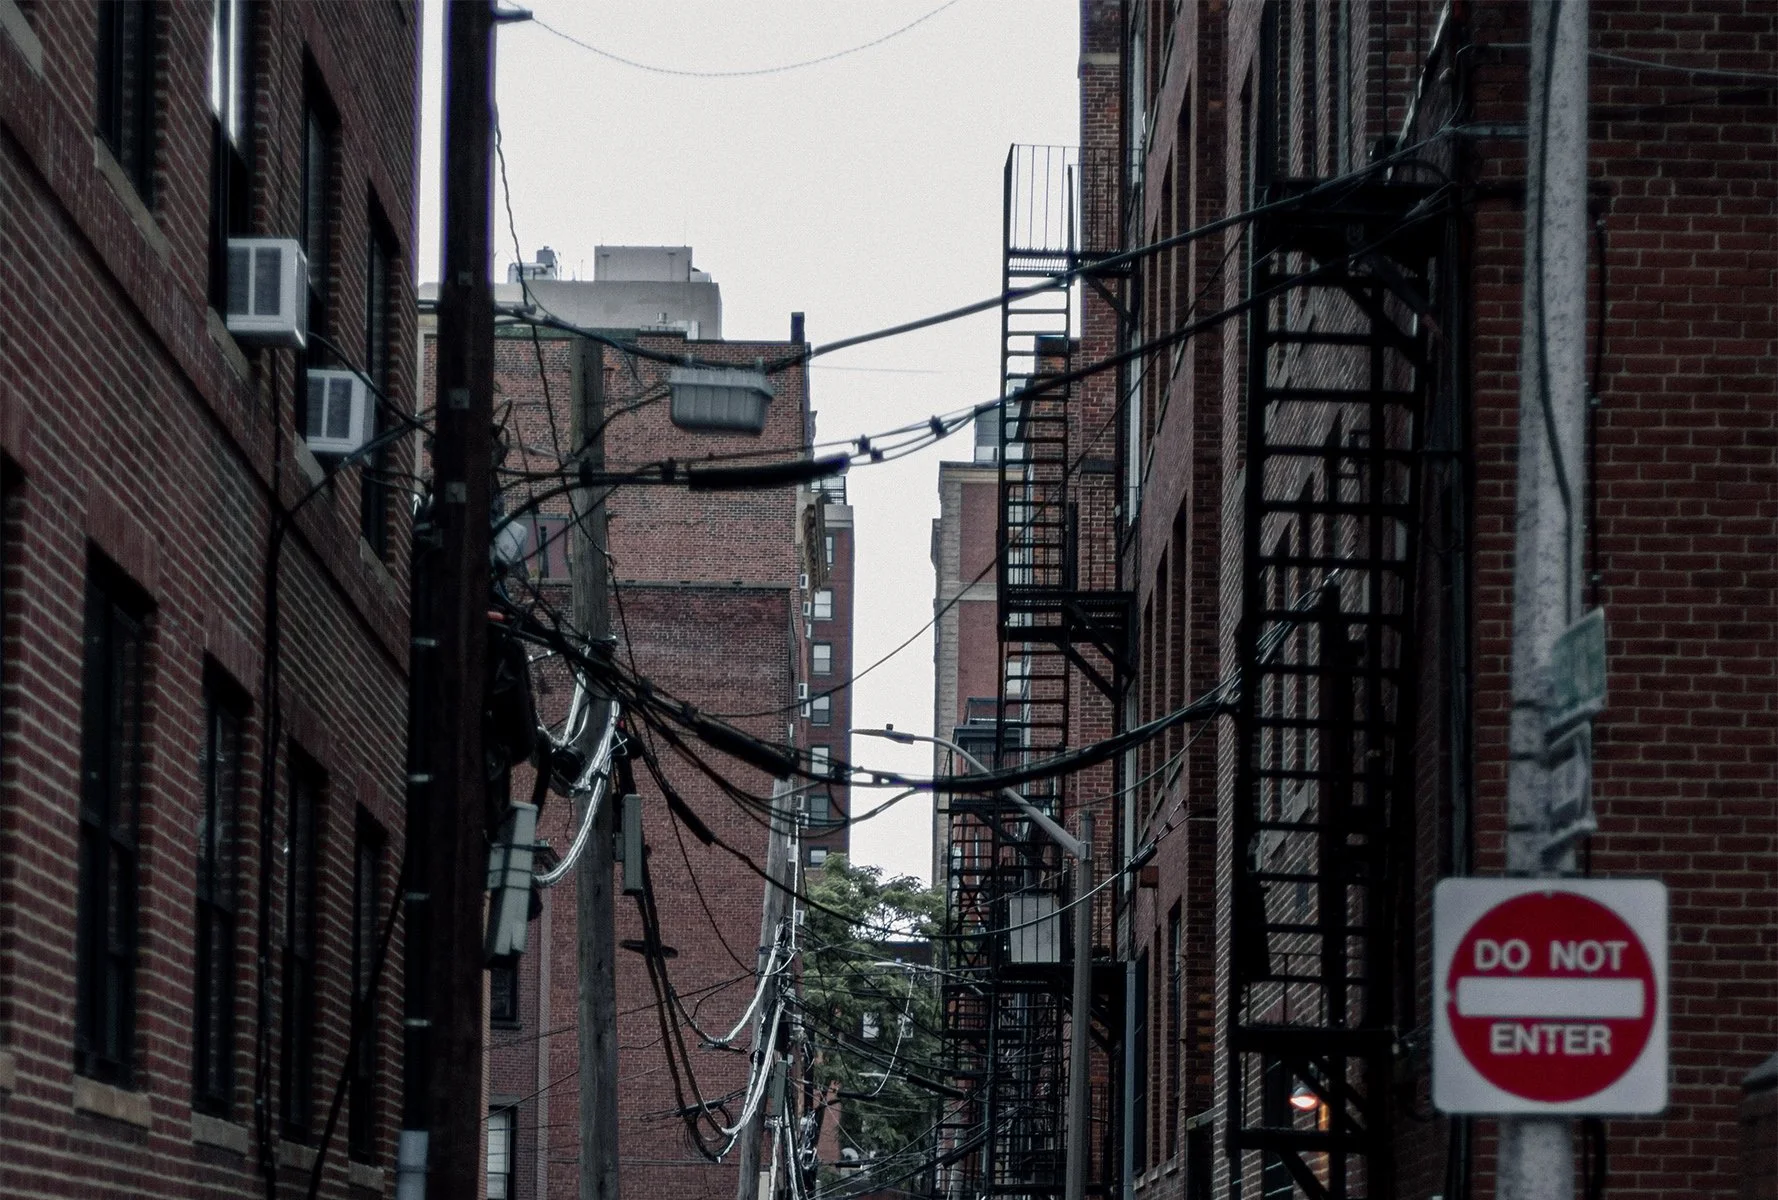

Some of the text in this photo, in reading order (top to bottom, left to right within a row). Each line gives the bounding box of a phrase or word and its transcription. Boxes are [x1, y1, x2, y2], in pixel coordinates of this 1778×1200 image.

[1474, 938, 1628, 972] DO NOT
[1489, 1023, 1613, 1056] ENTER
